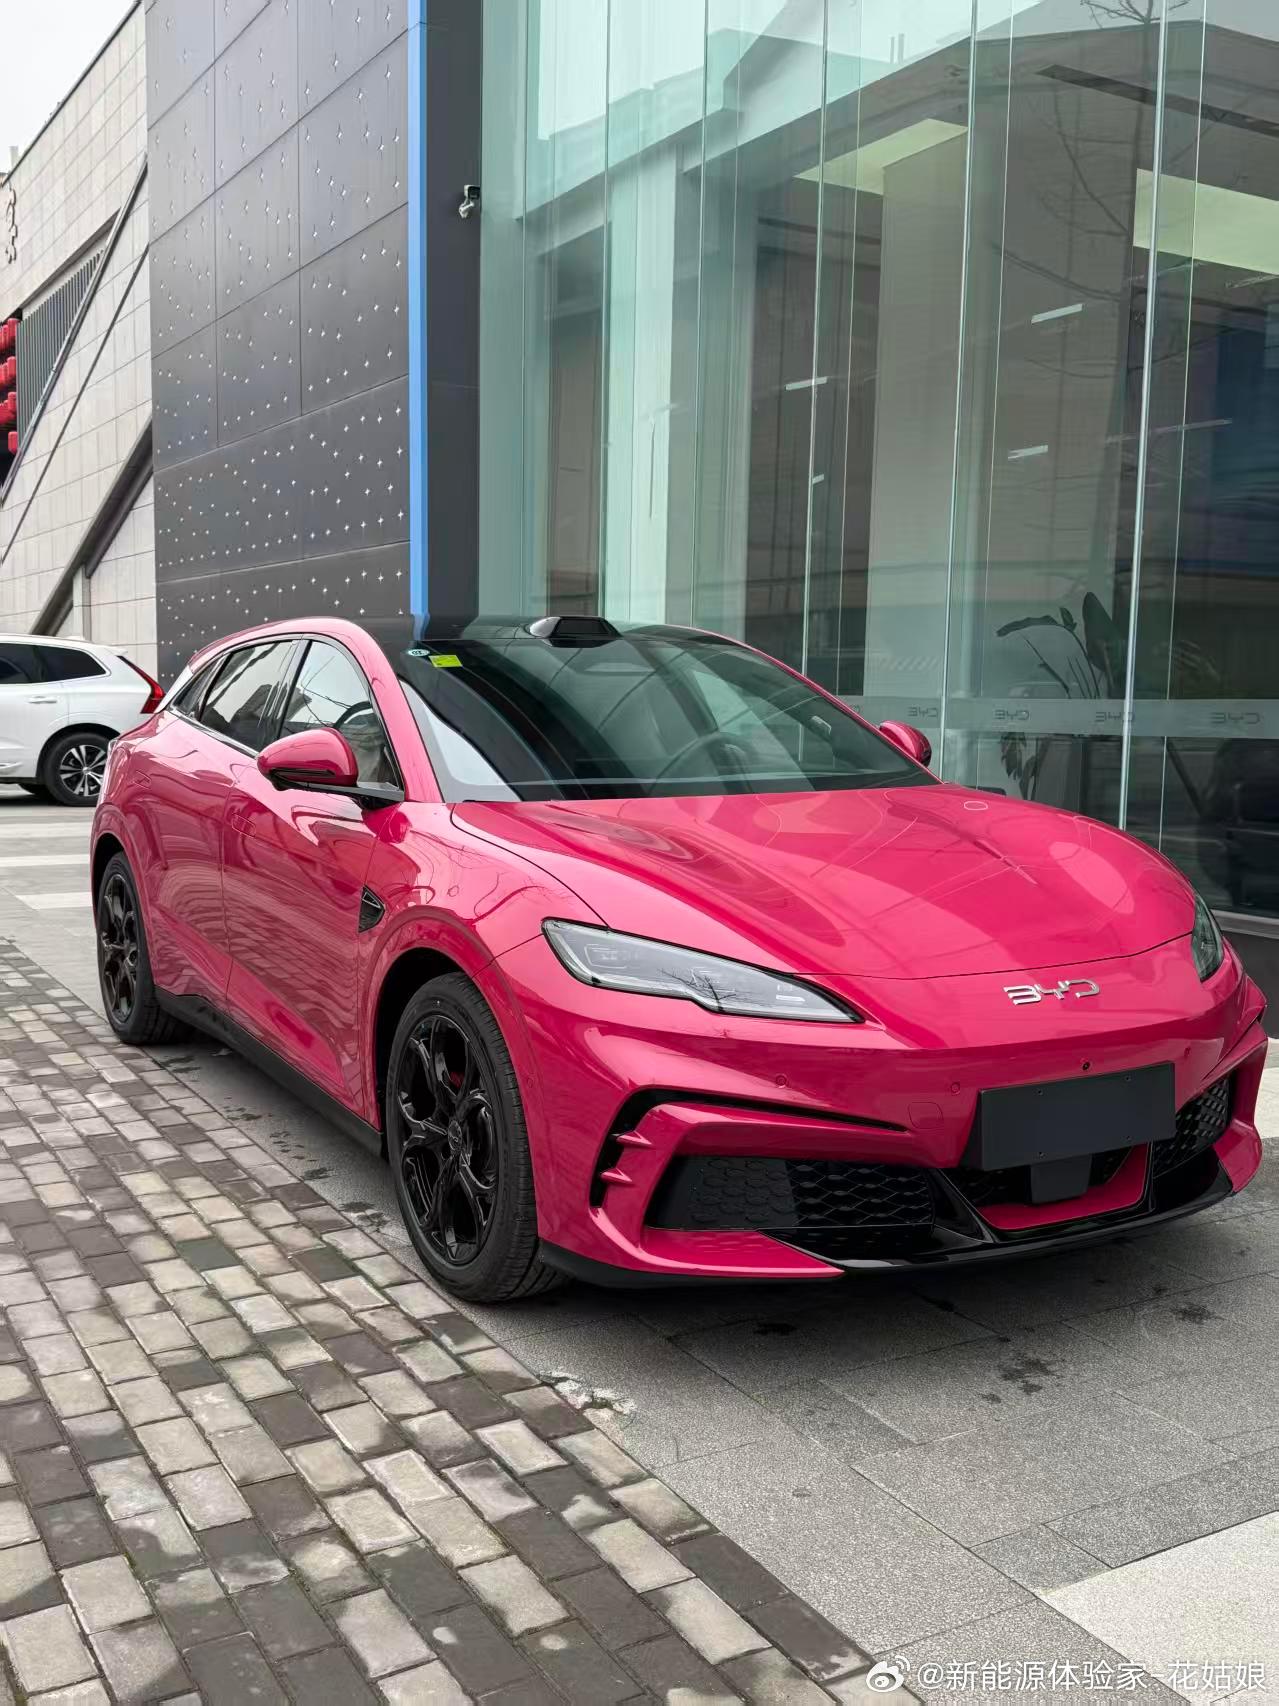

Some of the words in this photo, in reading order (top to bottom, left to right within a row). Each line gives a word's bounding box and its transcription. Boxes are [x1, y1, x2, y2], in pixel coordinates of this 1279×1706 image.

[907, 706, 938, 718] BYD
[994, 709, 1029, 720] BYD
[1209, 712, 1261, 725] BYD
[1003, 978, 1100, 1006] BYD
